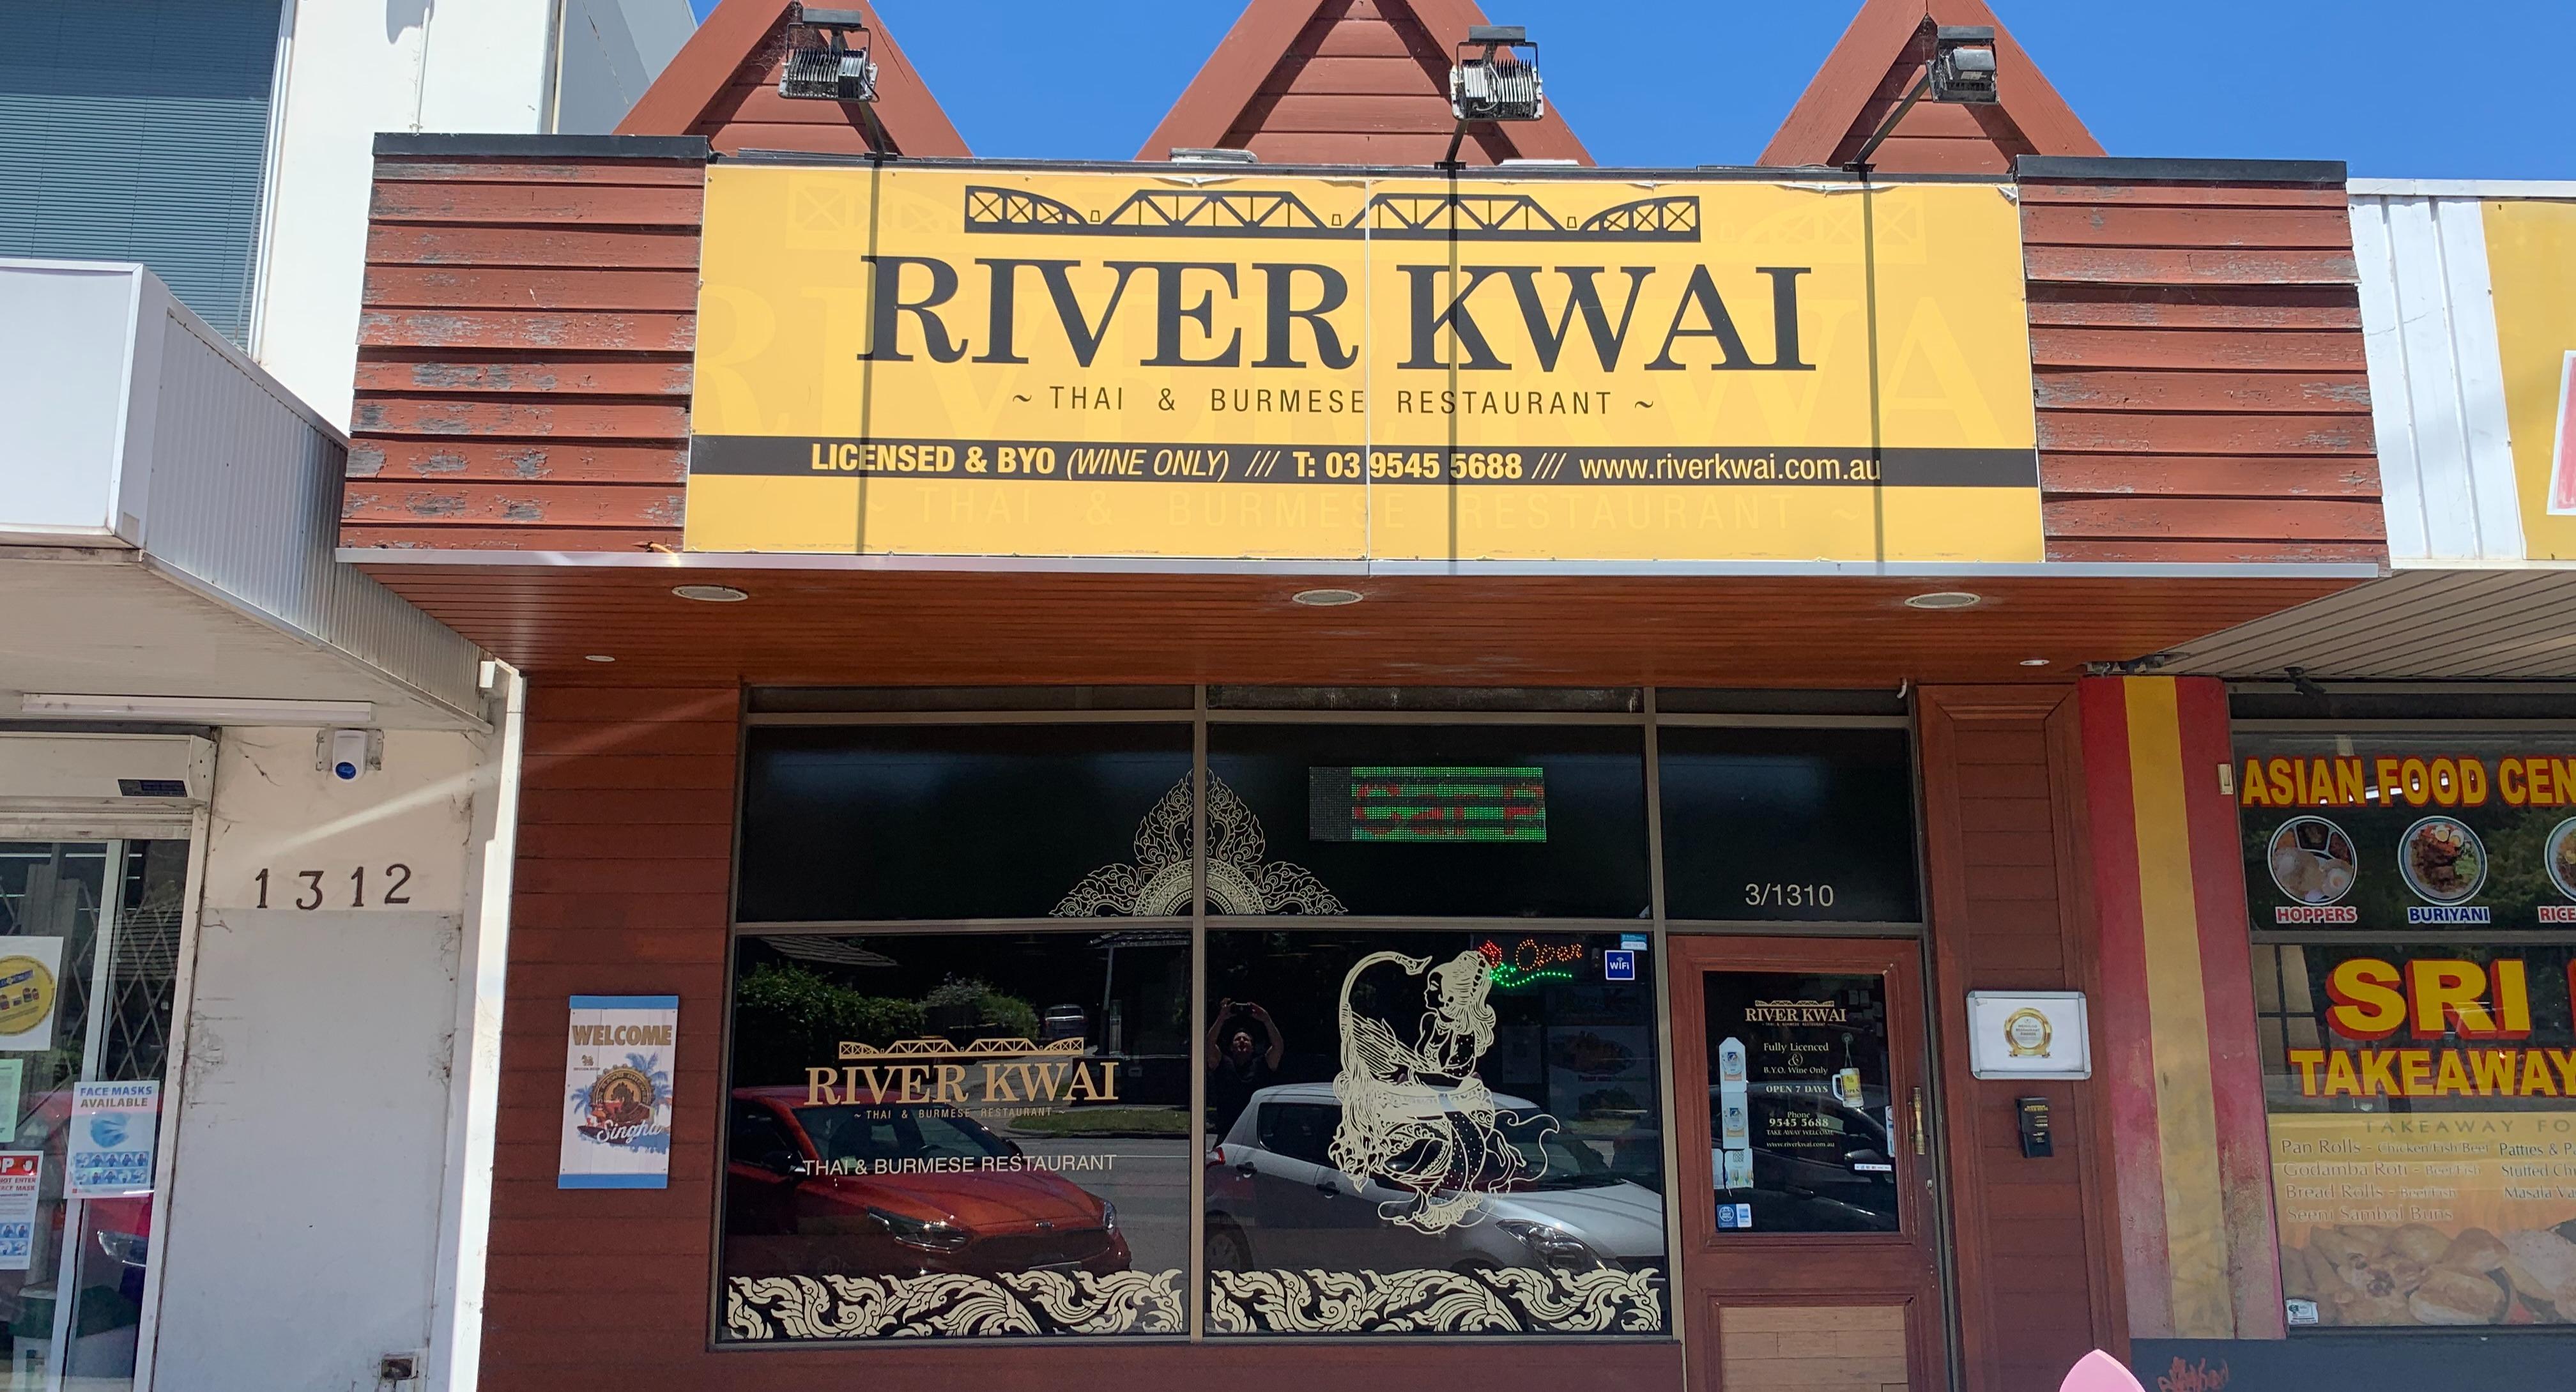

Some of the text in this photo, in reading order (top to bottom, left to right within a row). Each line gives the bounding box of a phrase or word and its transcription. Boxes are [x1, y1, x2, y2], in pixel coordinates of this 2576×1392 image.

[857, 256, 1816, 373] RIVER KWAI
[1050, 385, 1123, 410] THAI
[1158, 387, 1176, 411] &
[1211, 388, 1365, 413] BURMESE
[1397, 390, 1612, 415] RESTAURANT
[810, 442, 955, 472] LICENSED
[965, 447, 988, 473] &
[997, 446, 1056, 474] BYO
[1066, 448, 1147, 479] (WINE
[1153, 449, 1230, 482] ONLY)
[1292, 451, 1316, 478] T:
[1325, 451, 1361, 478] 03
[1369, 451, 1441, 478] 9545
[1450, 452, 1523, 480] 5688
[1579, 451, 1882, 482] www.riverkwai.com.au
[2239, 754, 2576, 807] ASIAN FOOD CEN
[1745, 883, 1834, 907] 3/1310
[2275, 906, 2358, 924] HOPPERS
[2407, 906, 2490, 924] BURIYANI
[2538, 906, 2576, 924] RICE
[1515, 938, 1583, 971] Open
[2326, 958, 2531, 1040] SRI
[1745, 1008, 1847, 1021] RIVER KWAI
[571, 1025, 673, 1046] WELCOME
[1763, 1043, 1829, 1053] Fully Licenced
[1809, 1066, 1828, 1075] Only
[2287, 1048, 2576, 1098] TAKEAWAY
[80, 1086, 153, 1097] FACE MASKS
[804, 1062, 1119, 1106] RIVER KWAI
[80, 1097, 148, 1108] AVAILABLE
[866, 1110, 891, 1120] THAI
[901, 1110, 908, 1119] &
[919, 1108, 970, 1119] BURMESE
[981, 1106, 1052, 1118] RESTAURANT
[597, 1119, 663, 1144] Singha
[1769, 1118, 1829, 1127] 9545 5688
[2365, 1119, 2513, 1134] TAKEAWAY
[2281, 1140, 2312, 1154] Pan
[2319, 1138, 2361, 1154] Rolls
[2499, 1142, 2543, 1156] Patties
[2549, 1142, 2558, 1156] &
[802, 1154, 1118, 1176] THAI & BURMESE RESTAURANT
[2283, 1160, 2368, 1177] Godamba
[2374, 1161, 2408, 1176] Roti
[2501, 1163, 2549, 1177] Stuffed
[2286, 1184, 2334, 1199] Bread
[2342, 1183, 2384, 1198] Rolls
[2504, 1186, 2552, 1199] Masala
[2288, 1205, 2453, 1223] Seeni Sambol Buns
